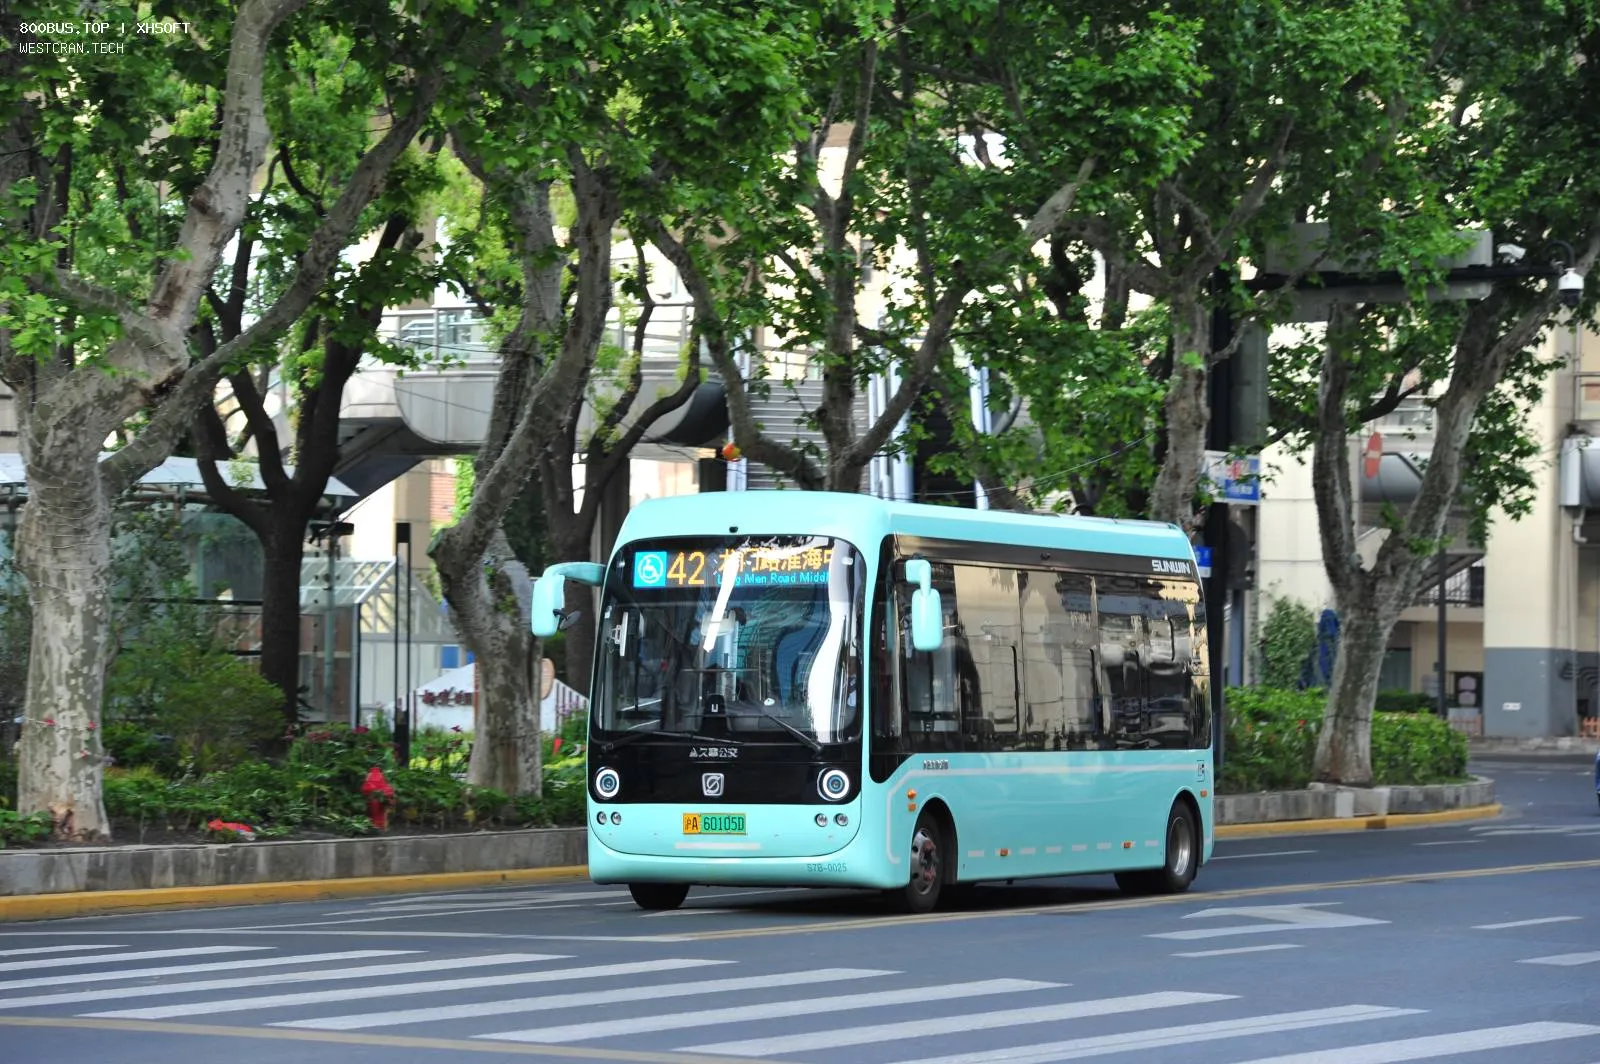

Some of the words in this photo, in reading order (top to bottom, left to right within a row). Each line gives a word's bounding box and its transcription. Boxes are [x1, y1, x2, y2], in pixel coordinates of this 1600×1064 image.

[666, 551, 705, 585] 42
[1151, 559, 1190, 574] SUNWIN
[770, 572, 796, 585] Road
[703, 816, 745, 831] 60105D
[806, 863, 848, 873] S7B-0025
